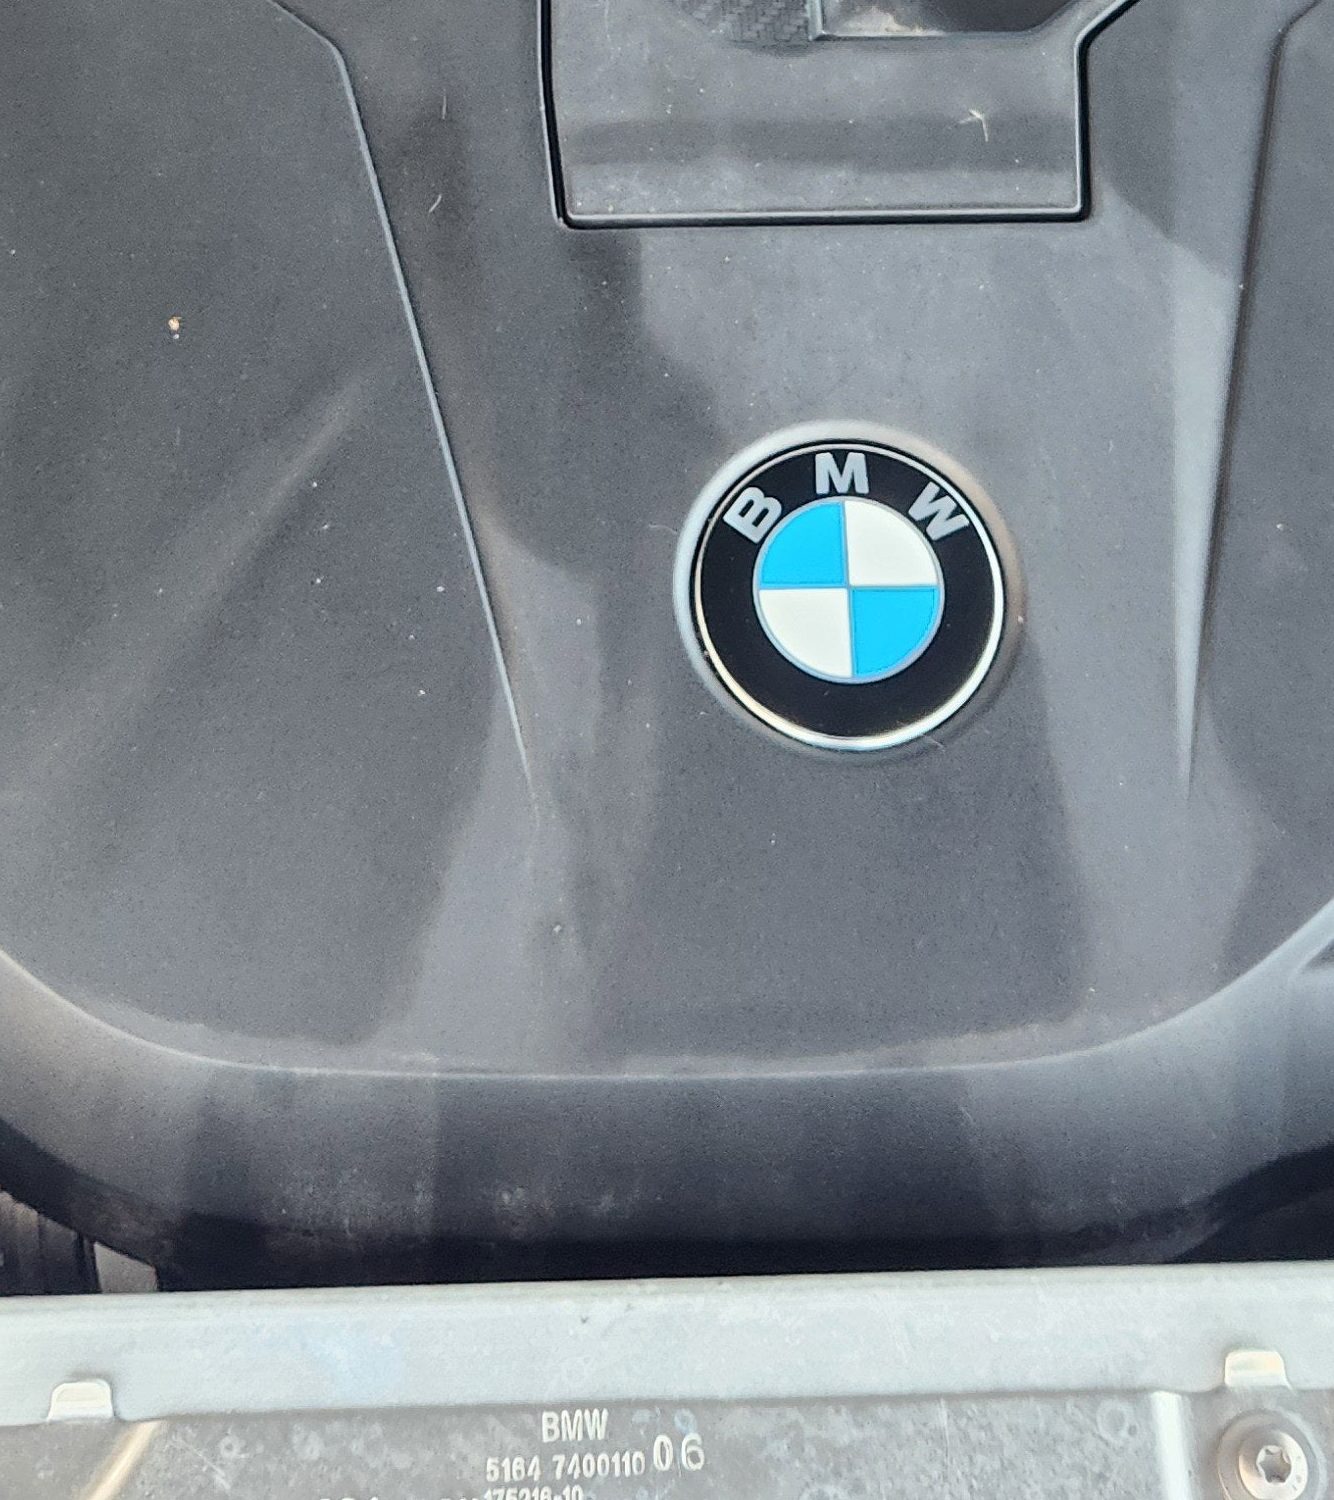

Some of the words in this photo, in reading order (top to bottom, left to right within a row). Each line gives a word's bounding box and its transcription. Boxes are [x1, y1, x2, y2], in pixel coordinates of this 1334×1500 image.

[722, 451, 970, 545] BMW
[541, 1407, 609, 1443] BMW
[485, 1454, 542, 1483] 5164
[551, 1449, 646, 1479] 7400110
